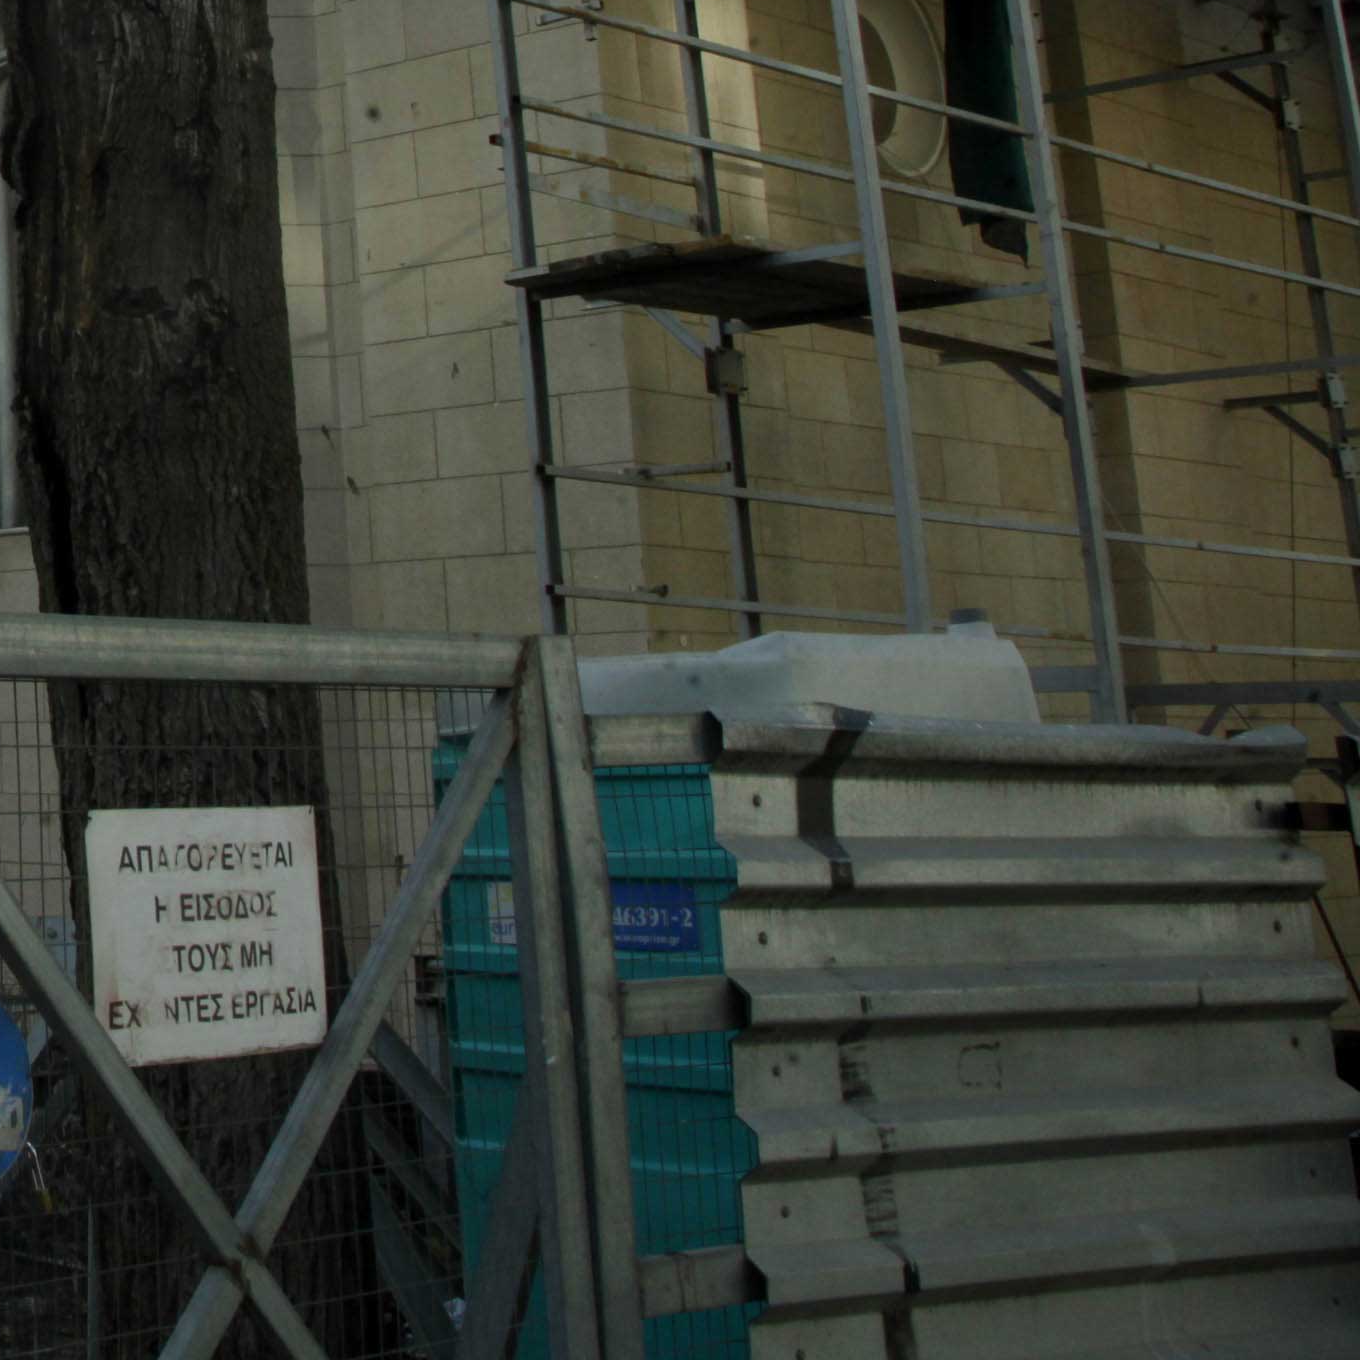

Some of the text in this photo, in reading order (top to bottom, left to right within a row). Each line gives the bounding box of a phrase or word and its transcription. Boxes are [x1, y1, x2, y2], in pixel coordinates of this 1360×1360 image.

[180, 892, 278, 922] ΕΙΣΟΔΟΣ
[240, 941, 272, 969] ΜΗ
[108, 987, 316, 1030] ΕΧΝΤΕΣ ΕΡΓΑΣΙΑ
